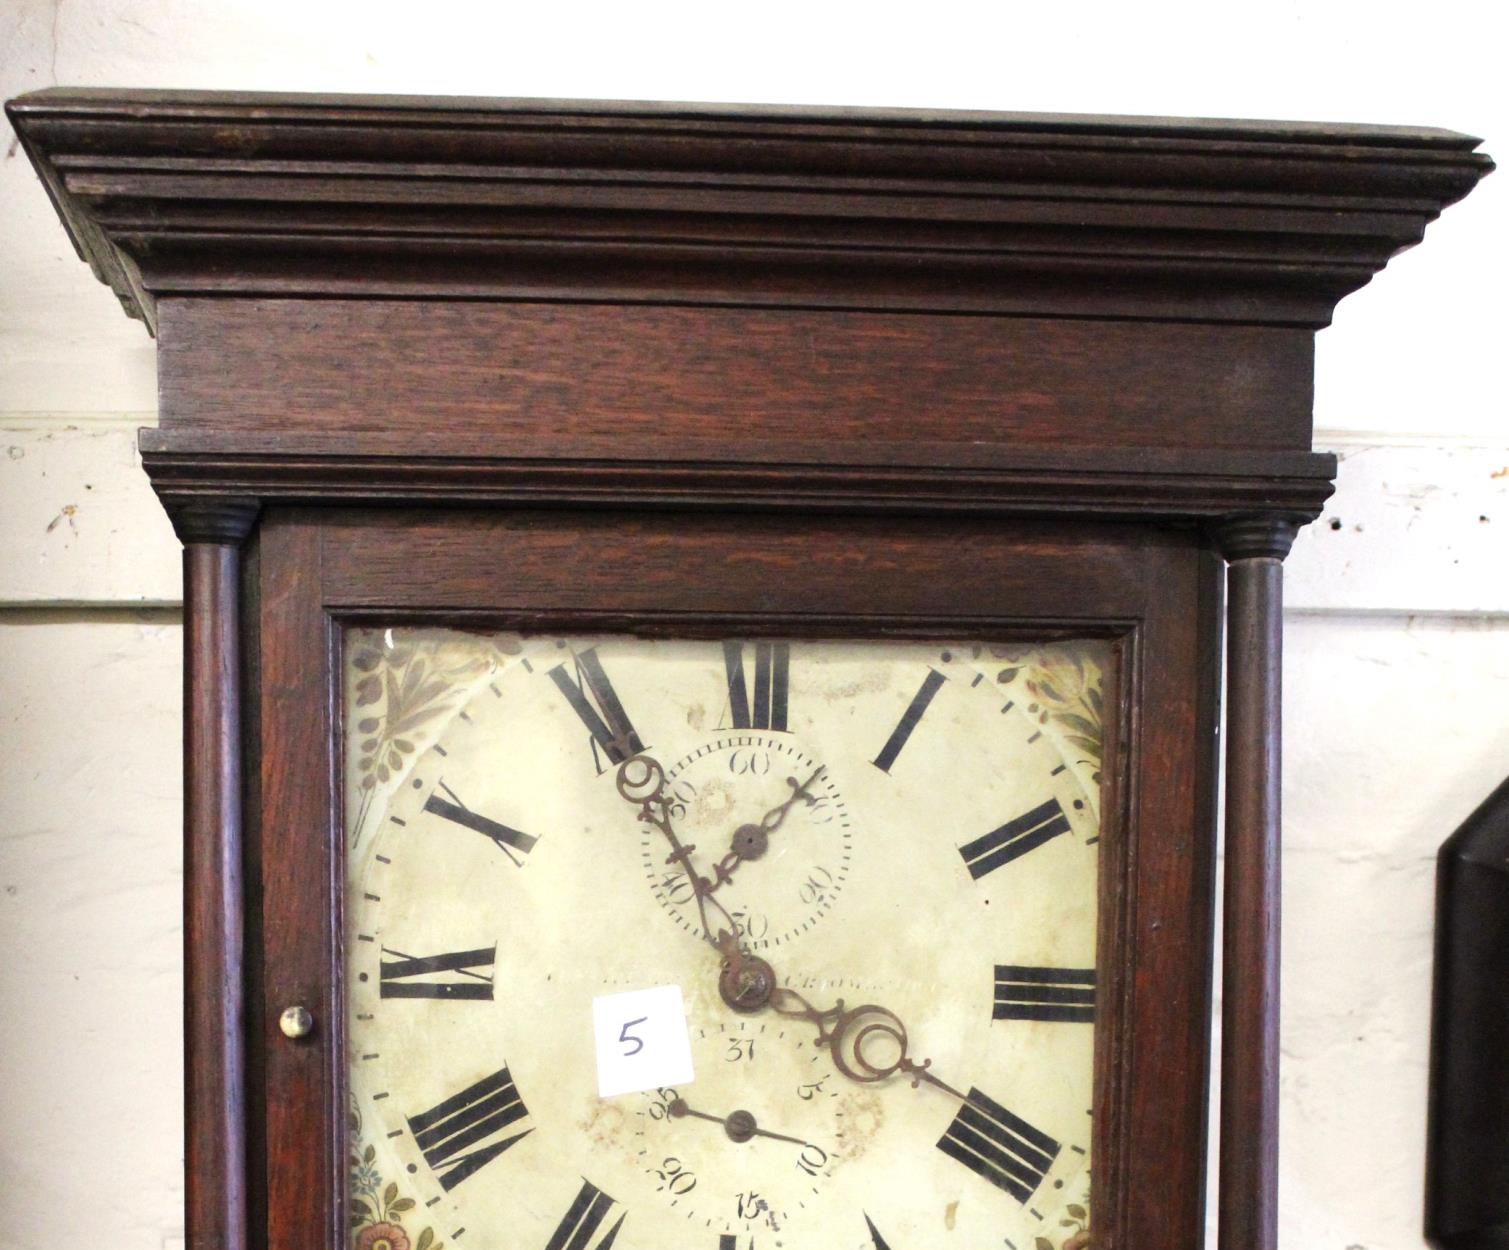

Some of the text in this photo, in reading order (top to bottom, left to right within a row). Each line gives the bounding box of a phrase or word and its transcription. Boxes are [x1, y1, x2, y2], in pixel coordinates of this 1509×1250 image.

[867, 664, 951, 777] I
[729, 749, 770, 776] 60
[420, 775, 542, 868] X
[954, 796, 1074, 886] II
[990, 964, 1097, 1028] III
[618, 1016, 648, 1057] 5
[796, 1143, 828, 1178] 10
[735, 1191, 760, 1220] 15
